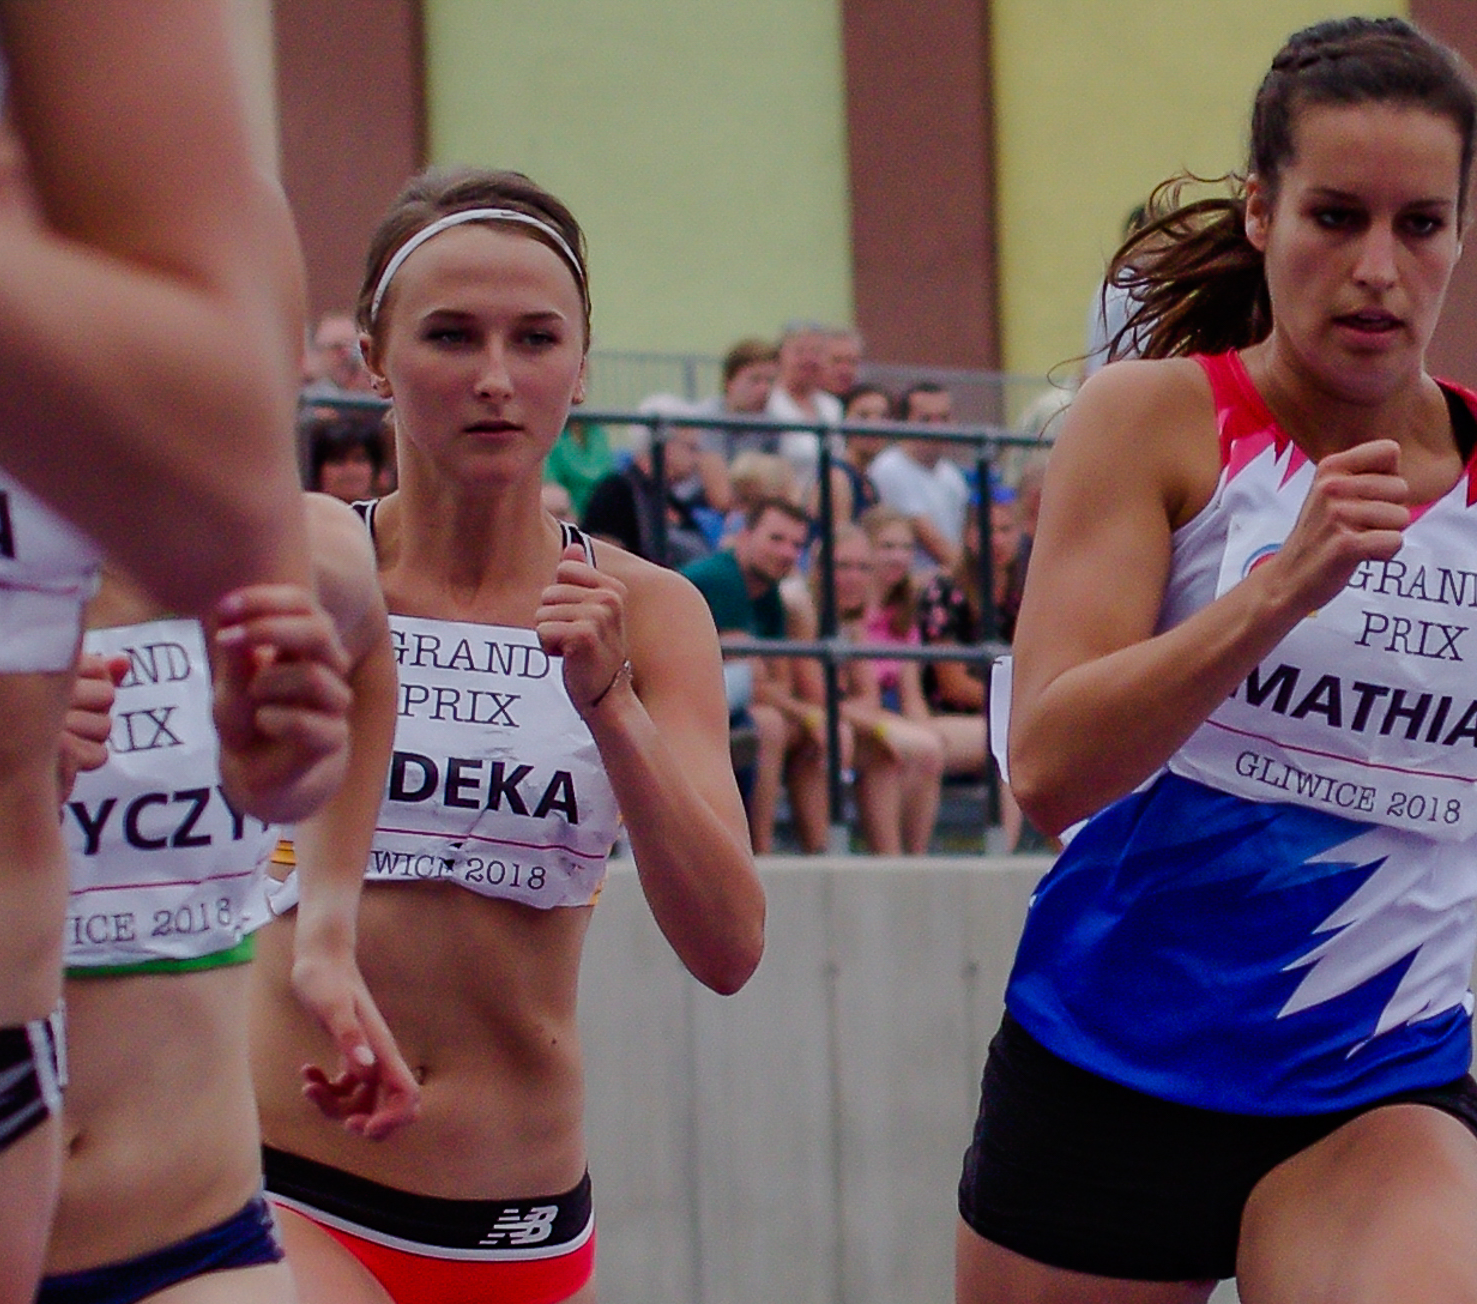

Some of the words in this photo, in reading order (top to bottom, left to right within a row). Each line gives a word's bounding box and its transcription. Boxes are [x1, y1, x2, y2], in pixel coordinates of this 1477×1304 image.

[1355, 611, 1469, 661] PRIX
[397, 684, 522, 727] PRIX
[1235, 751, 1376, 813] GLIWICE
[1386, 792, 1461, 824] 2018
[60, 783, 270, 858] YCZY
[465, 857, 546, 890] 2018
